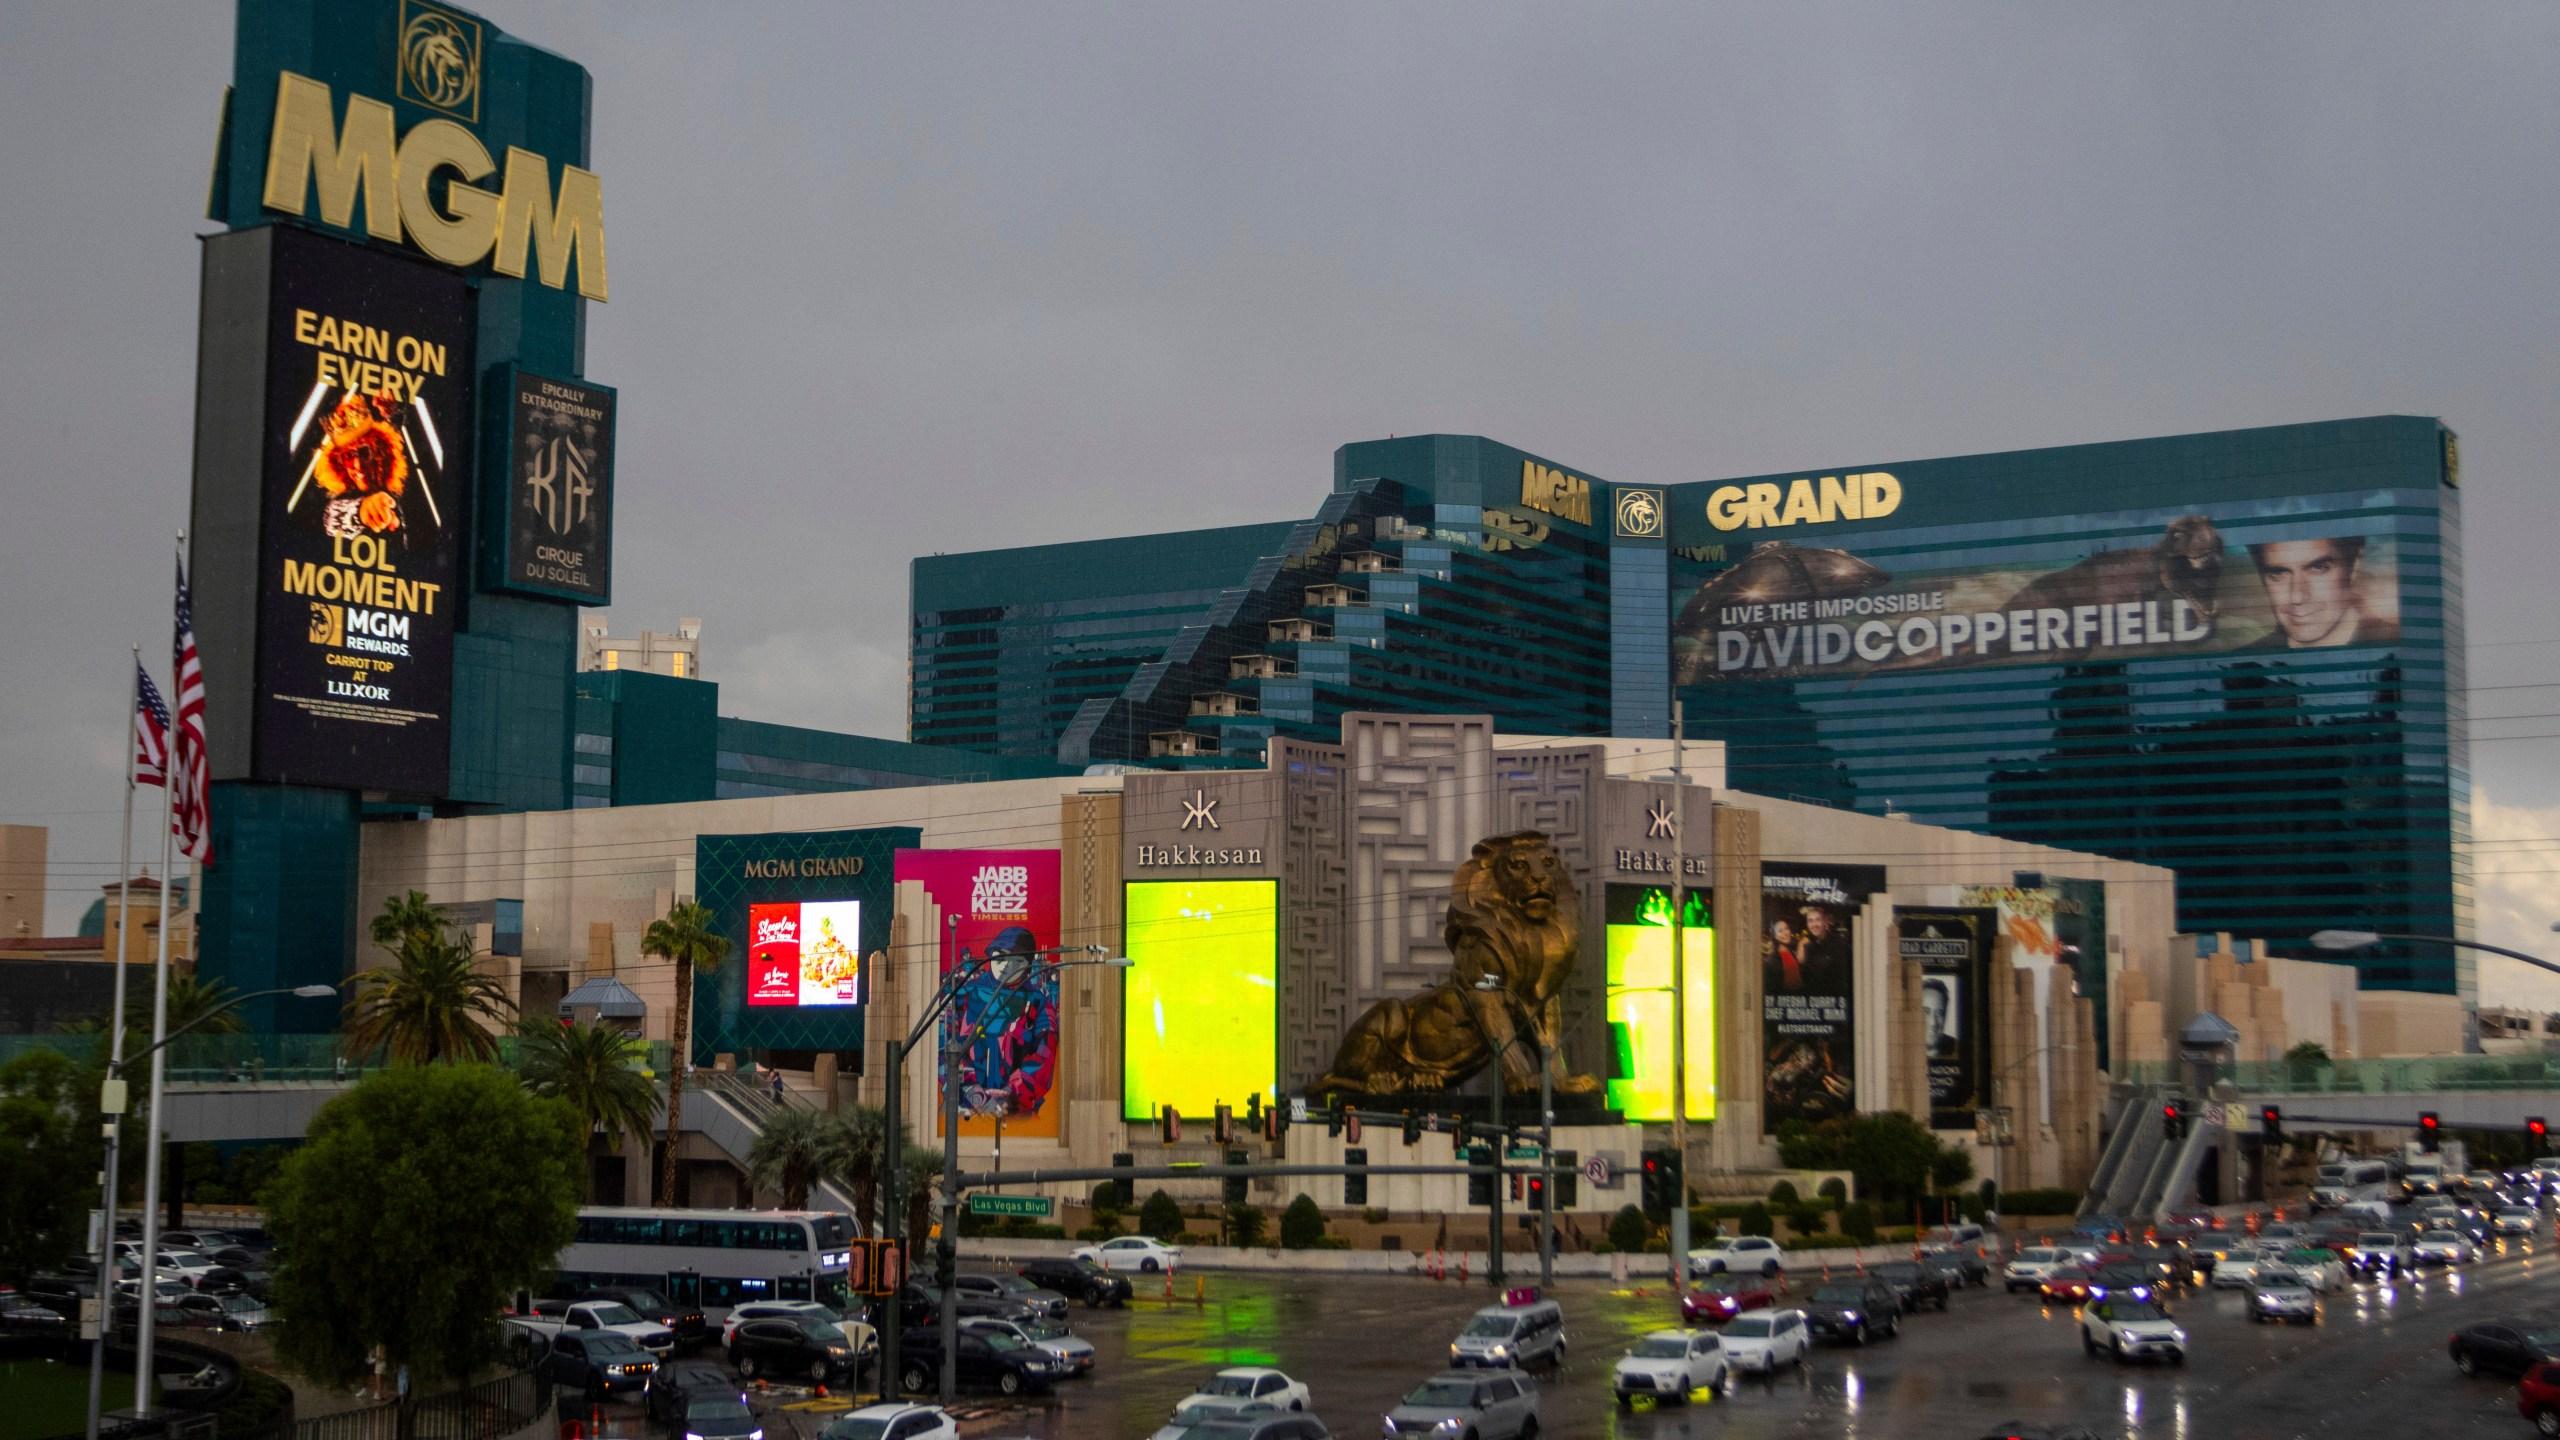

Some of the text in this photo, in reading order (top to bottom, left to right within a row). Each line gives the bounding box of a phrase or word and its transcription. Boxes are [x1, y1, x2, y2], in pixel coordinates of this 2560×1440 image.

[262, 70, 608, 303] MGM
[296, 309, 446, 376] EARN ON
[317, 351, 425, 405] EVERY
[542, 382, 585, 402] EPICALLY
[522, 392, 603, 422] EXTRAORDINARY
[1521, 459, 1592, 527] MGM
[1706, 472, 1901, 531] GRAND
[333, 532, 396, 573] LOL
[536, 545, 583, 569] CIRQUE
[283, 559, 440, 615] MOMENT
[526, 563, 591, 587] DU SOLEIL
[1721, 591, 1943, 625] LIVE THE IMPOSSIBLE
[347, 607, 410, 640] MGM
[326, 653, 394, 673] CARROT TOP
[353, 672, 368, 682] AT
[327, 680, 391, 701] LUXOR
[1138, 843, 1262, 866] Hakkasan
[1618, 849, 1706, 874] Hakkaan
[744, 856, 864, 879] MGM GRAND
[971, 866, 1028, 882] JABB
[971, 882, 1028, 897] AWOC
[971, 896, 1028, 913] KEEZ
[971, 913, 1028, 921] TIMELESS
[974, 1199, 1047, 1213] Las Vegas Blvd
